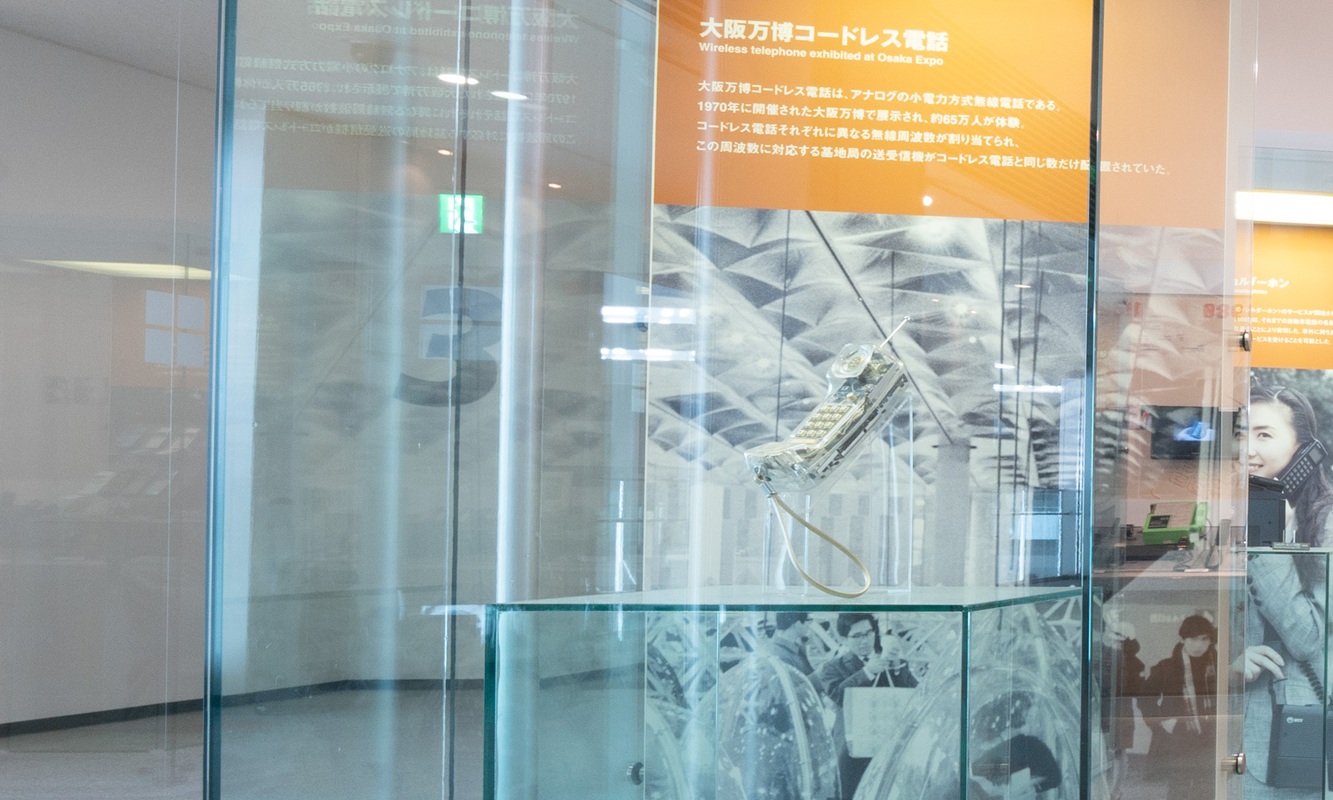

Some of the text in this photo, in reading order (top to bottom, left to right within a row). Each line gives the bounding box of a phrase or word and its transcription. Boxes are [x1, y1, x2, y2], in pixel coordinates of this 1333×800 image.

[699, 17, 949, 52] 大阪万博コードレス電話
[699, 42, 944, 66] Wireless telephone exhibited at Osaka Expo
[698, 80, 1061, 112] 大阪万博コードレス電話は、アナログの小電力方式無線電話である。
[697, 101, 1025, 129] 1970年に開催された大阪万博で展示され、約65万人が体験。
[697, 121, 1020, 148] コードレス電話それぞれに異なる無線周波数が割り当てられ、
